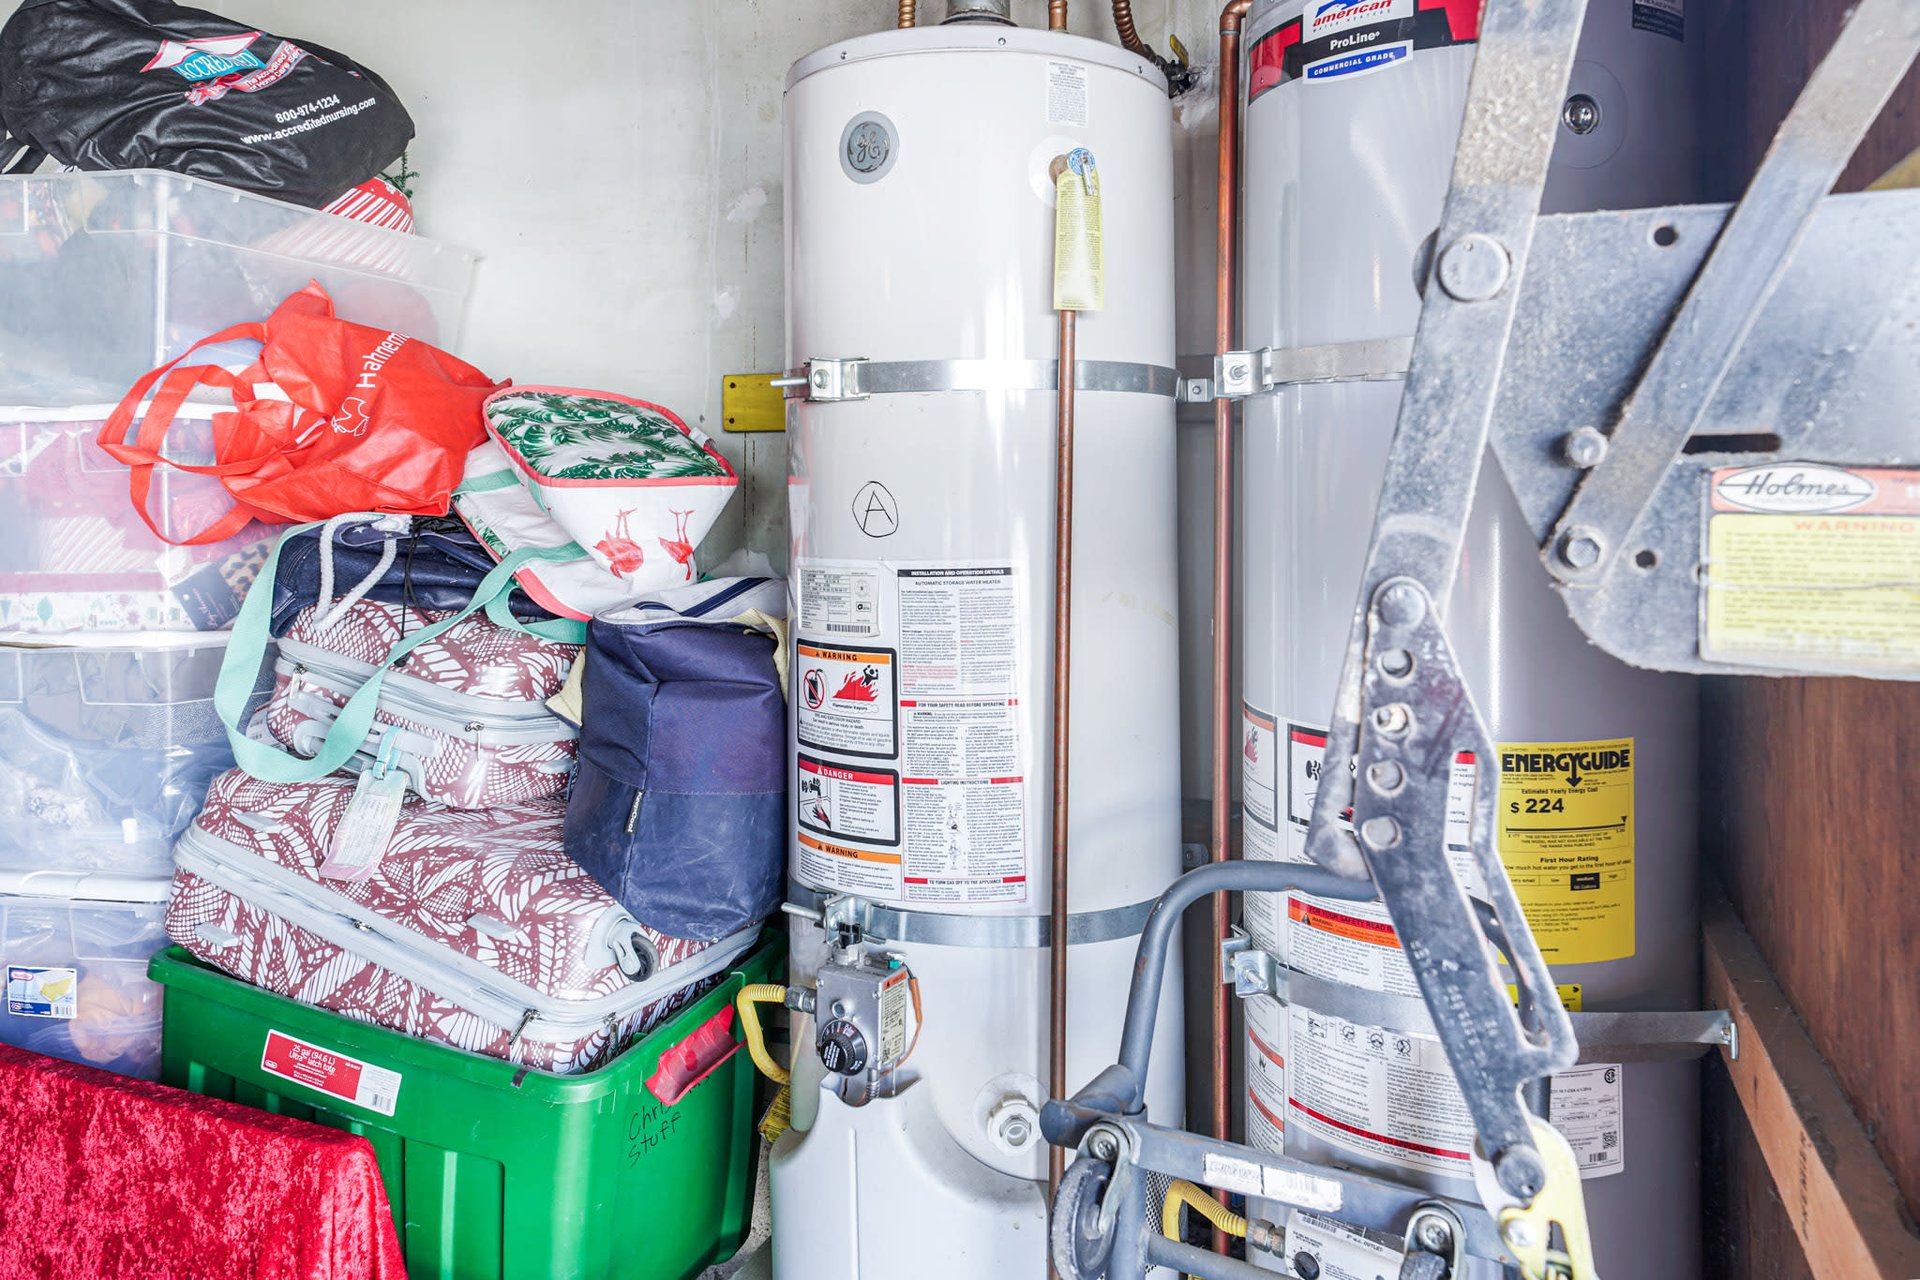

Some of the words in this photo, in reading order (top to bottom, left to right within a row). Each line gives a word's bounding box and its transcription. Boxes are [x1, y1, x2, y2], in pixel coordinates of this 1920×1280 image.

[1313, 0, 1392, 27] american
[1313, 58, 1362, 75] COMMERCIAL
[1365, 51, 1395, 63] GRADE
[275, 94, 340, 123] 800-974-1234
[240, 97, 376, 144] www.accreditednursing.com
[1743, 472, 1850, 497] Holmes
[1794, 520, 1916, 534] WARNING
[822, 651, 858, 661] WARNING
[823, 769, 854, 780] DANGER
[1568, 787, 1586, 795] Energy
[1587, 785, 1598, 793] Cost
[1510, 801, 1520, 814] $
[1525, 798, 1565, 814] 224
[825, 845, 859, 858] WARNING
[1577, 855, 1599, 863] Rating
[292, 1044, 300, 1053] 25
